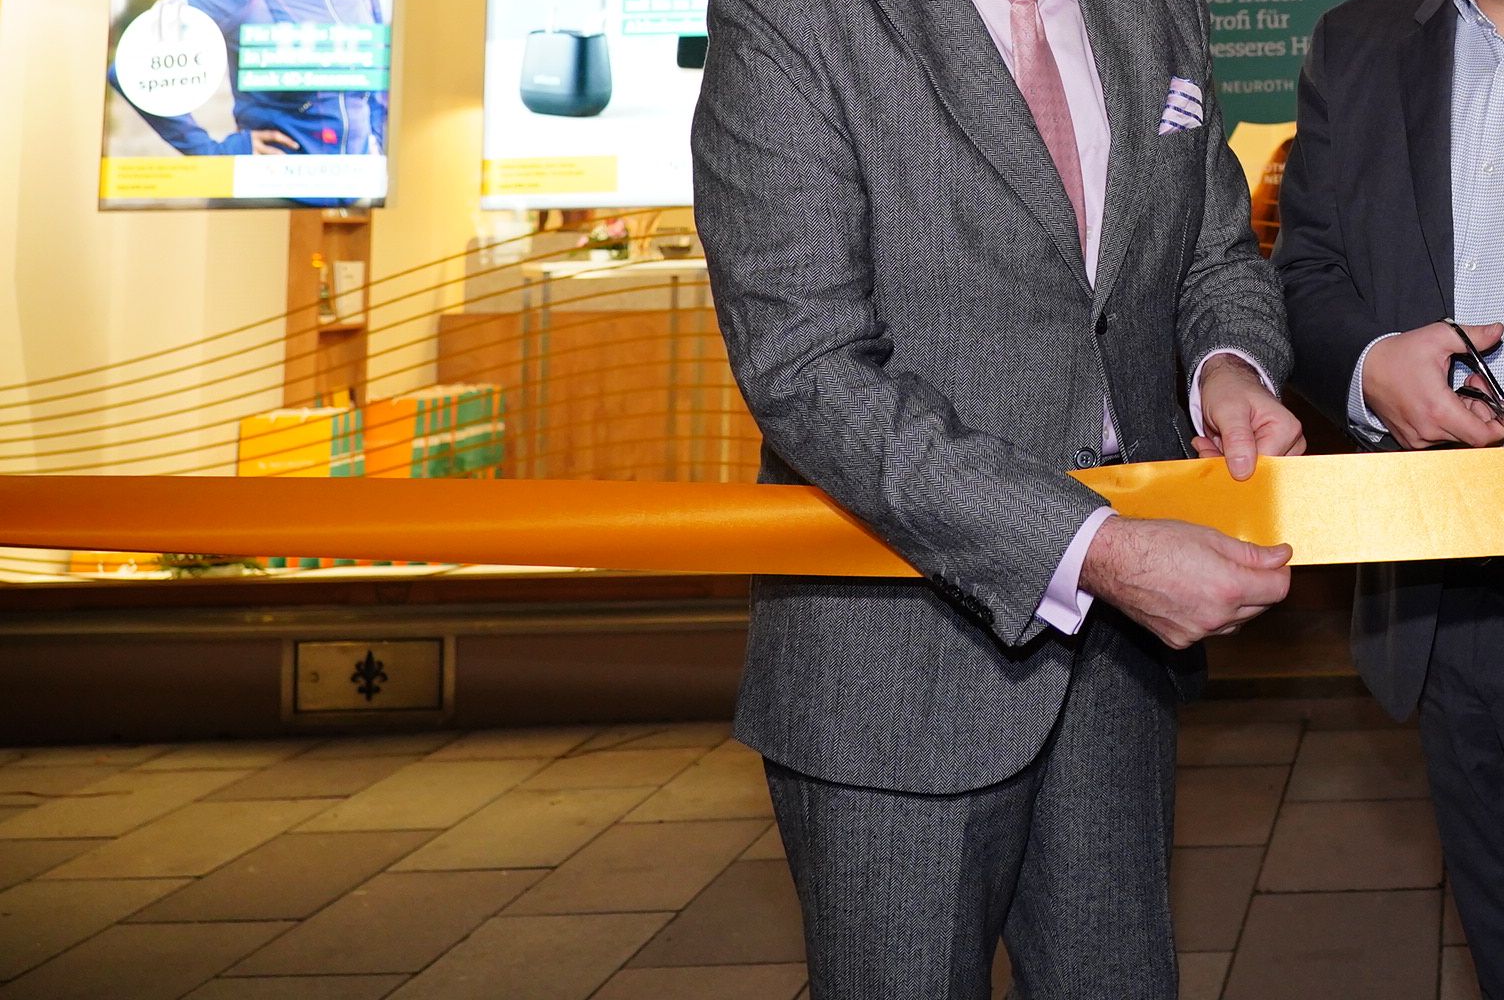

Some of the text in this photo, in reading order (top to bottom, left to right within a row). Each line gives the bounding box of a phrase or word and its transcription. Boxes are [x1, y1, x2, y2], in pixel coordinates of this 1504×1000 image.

[1256, 8, 1291, 30] für
[150, 53, 188, 69] 800
[1222, 80, 1294, 93] NEUROTH
